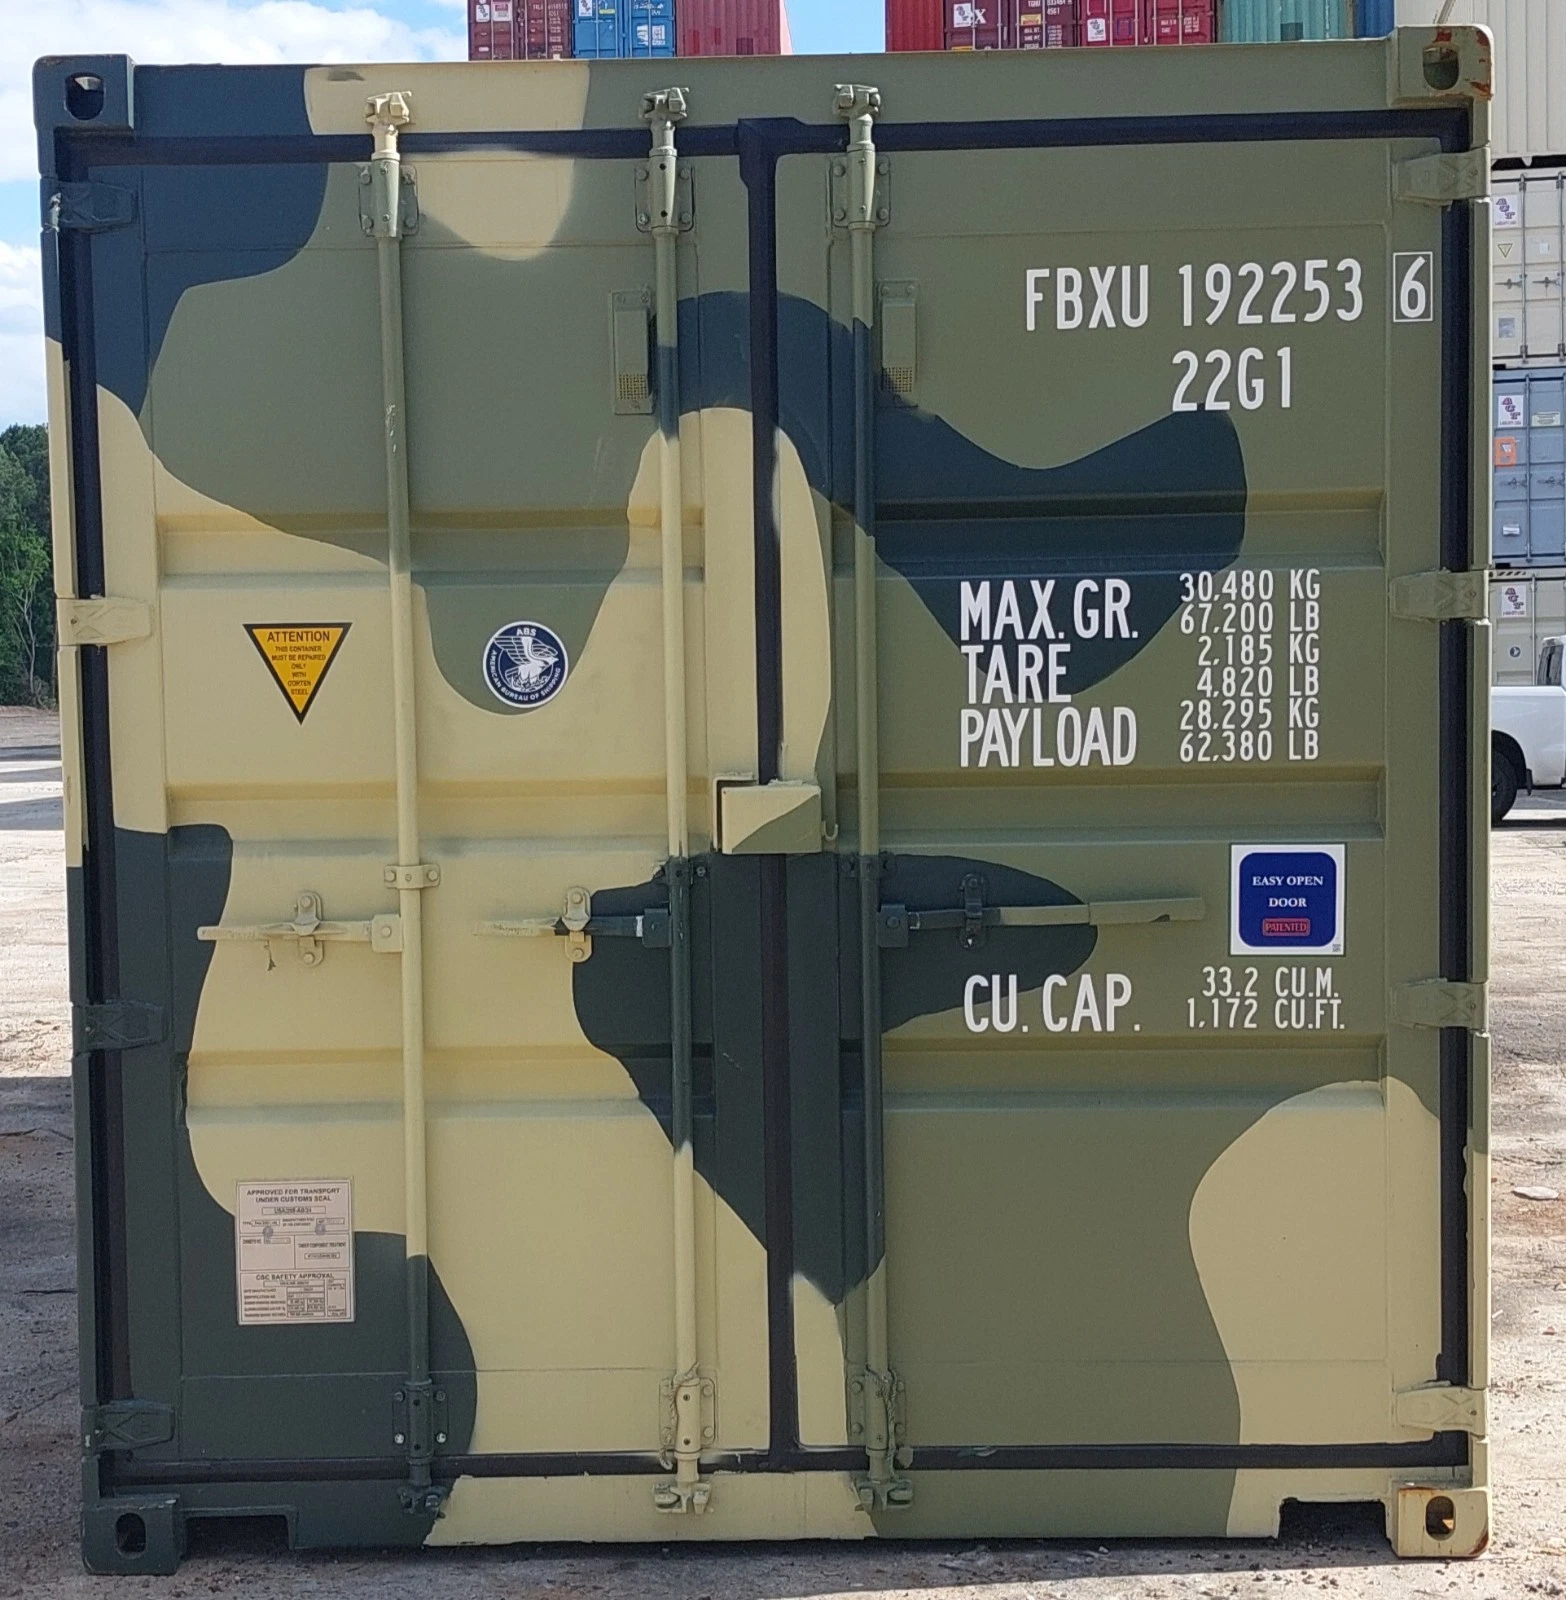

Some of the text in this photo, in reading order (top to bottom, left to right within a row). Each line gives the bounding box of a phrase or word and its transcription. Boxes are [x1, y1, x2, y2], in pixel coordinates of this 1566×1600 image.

[1025, 255, 1427, 331] FBXU 192253 6
[1171, 346, 1292, 412] 22G1
[1179, 570, 1274, 603] 30,480
[1289, 568, 1321, 600] KG
[516, 627, 537, 636] ABS
[1179, 601, 1320, 635] 67,200 LB
[267, 630, 331, 642] ATTENTION
[275, 645, 322, 653] THIS CONTAINER
[291, 662, 307, 670] ONLY
[489, 649, 502, 688] AMERICAN
[500, 686, 529, 701] BUREAU
[540, 667, 562, 696] SHIPPING
[960, 633, 1320, 705] TARE 2,185 KG
[1196, 665, 1320, 699] 4,820 LB
[287, 679, 312, 687] CORTEN
[960, 697, 1320, 768] PAYLOAD 28,295 KG
[1179, 728, 1320, 763] 62,380 LB
[1252, 876, 1324, 886] EASY OPEN
[1268, 897, 1307, 908] DOOR
[1265, 922, 1307, 932] PATENTED
[963, 966, 1339, 1033] CU. CAP. 33.2 CU.M.
[1187, 997, 1345, 1030] 1,172 CU.FT.
[246, 1188, 284, 1196] APPROVED
[280, 1195, 313, 1203] CUSTOMS
